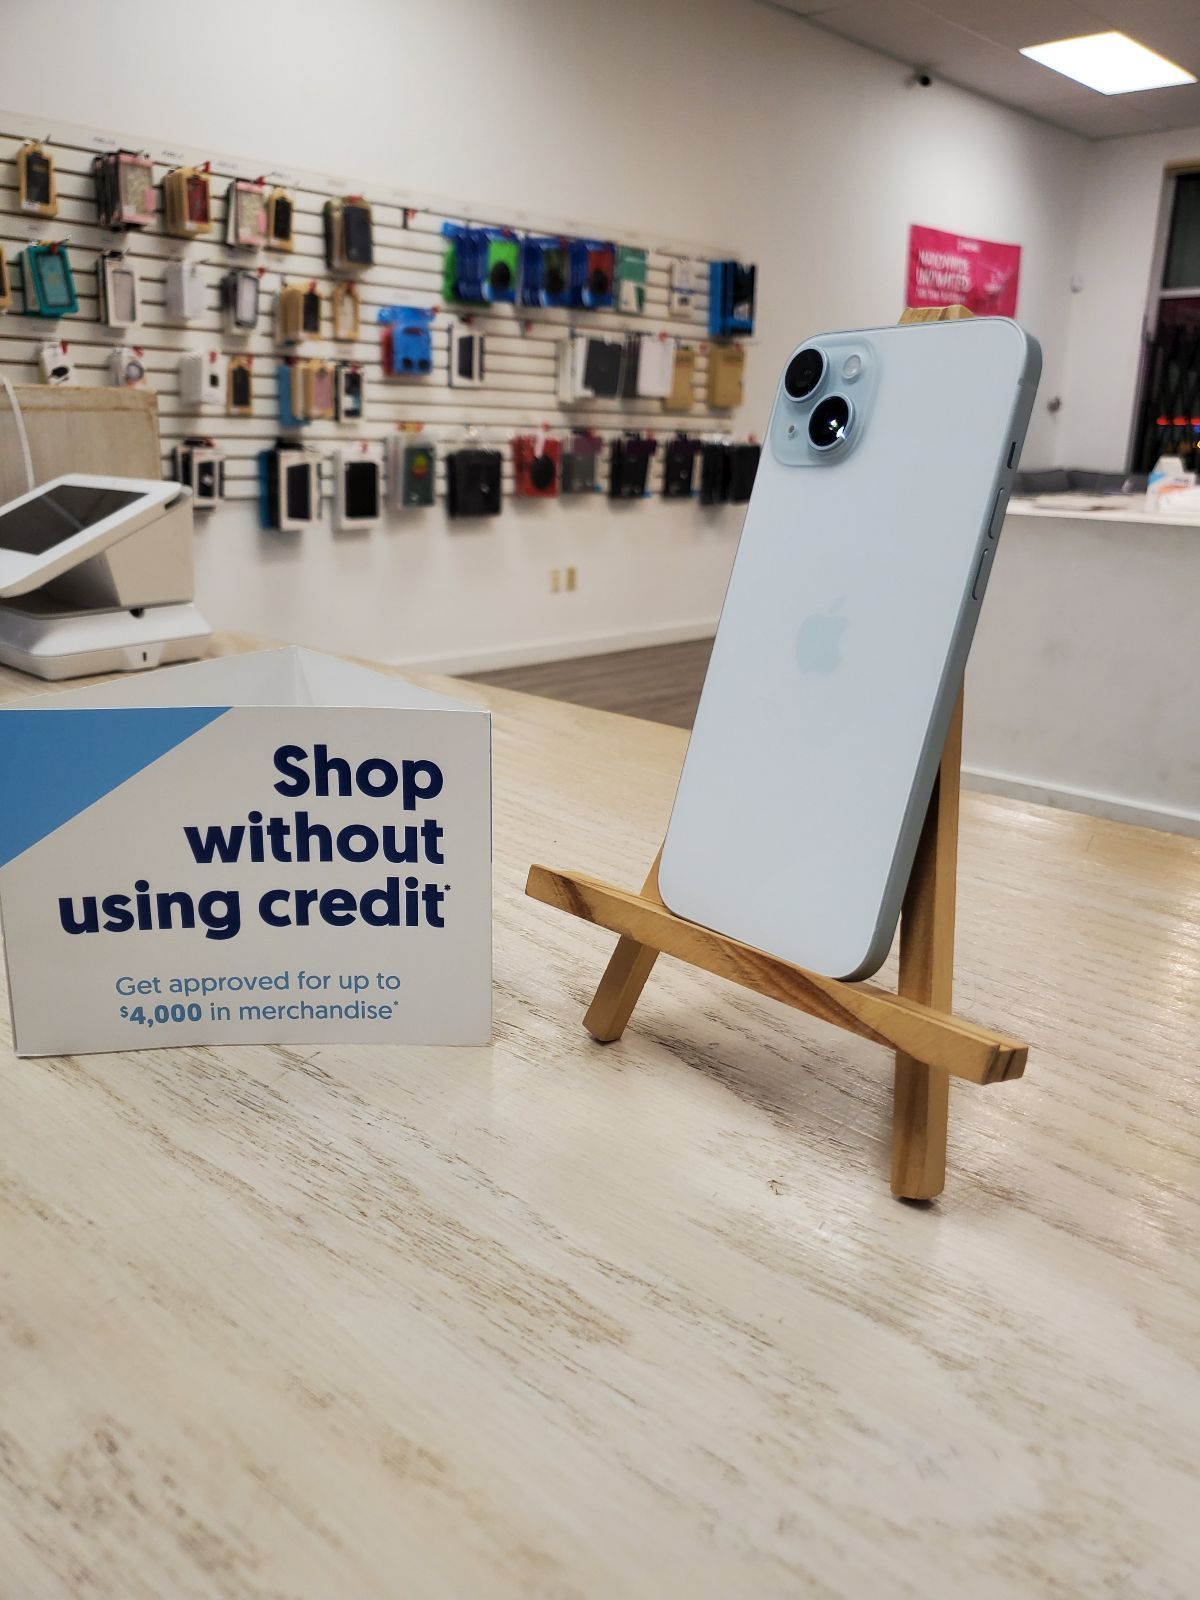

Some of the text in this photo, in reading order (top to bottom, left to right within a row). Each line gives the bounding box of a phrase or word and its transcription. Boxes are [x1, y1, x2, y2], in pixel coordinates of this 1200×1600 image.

[273, 744, 444, 811] Shop
[183, 811, 445, 864] without
[58, 879, 242, 941] using
[115, 971, 401, 997] Get approved for up to
[119, 1003, 202, 1028] $4,000
[210, 1002, 231, 1022] in
